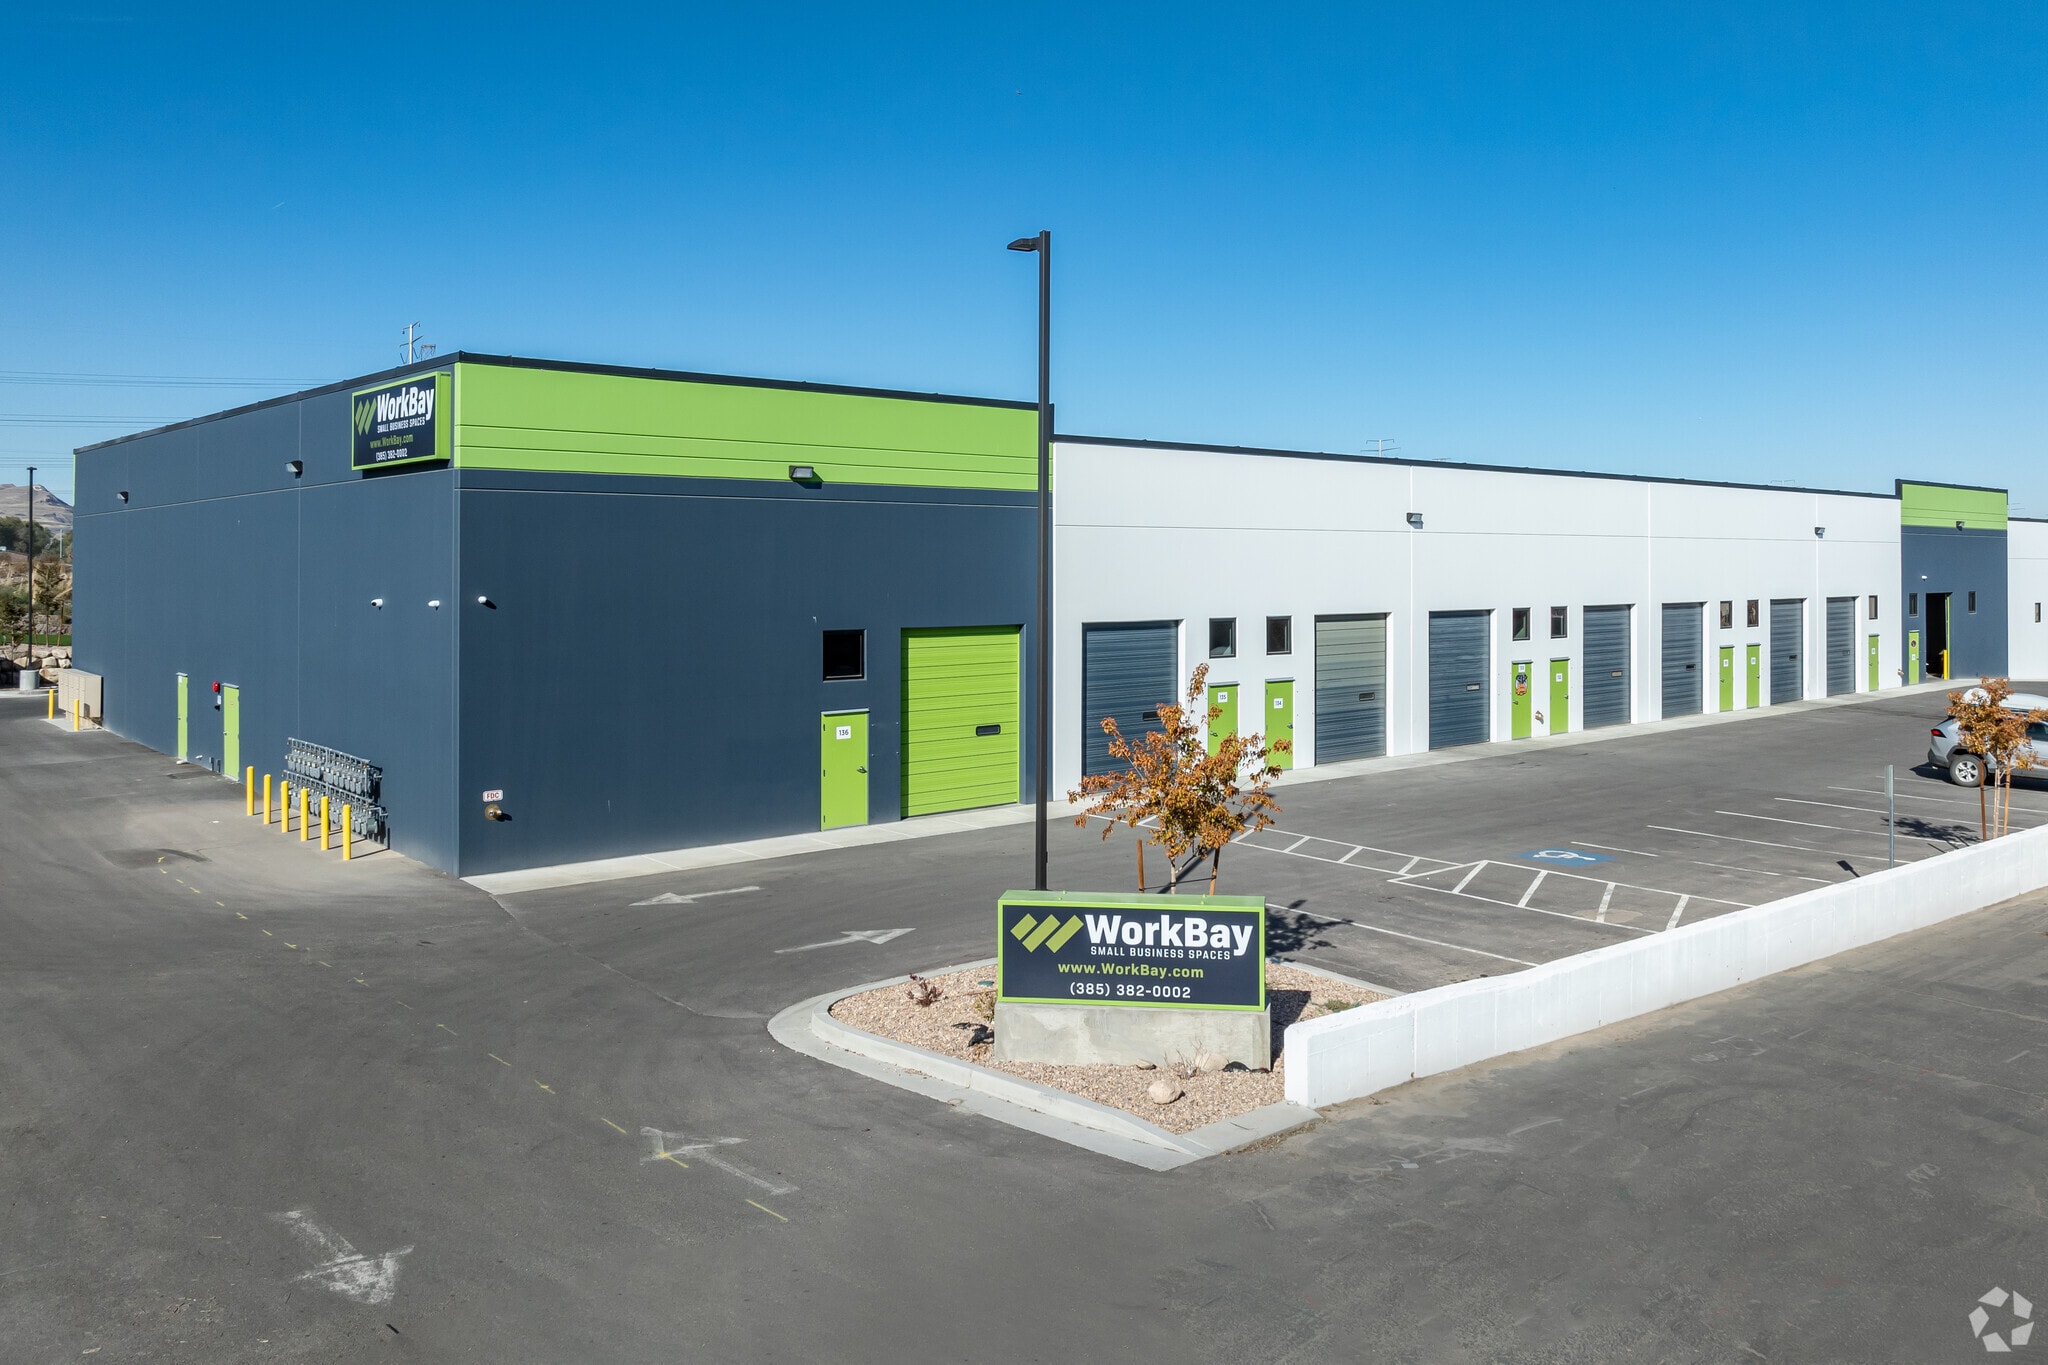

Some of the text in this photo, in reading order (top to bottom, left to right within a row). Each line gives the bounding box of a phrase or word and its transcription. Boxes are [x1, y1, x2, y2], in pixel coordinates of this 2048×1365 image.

[377, 386, 434, 422] WorkBay
[377, 417, 425, 433] SMALL BUSINESS SPACES
[369, 434, 413, 449] www.WorkBay.com
[1084, 914, 1254, 956] WorkBay
[1090, 946, 1231, 960] SMALL BUSINESS SPACES
[1057, 962, 1204, 979] www.WorkBay.com
[1069, 981, 1191, 999] (385) 382-0002
